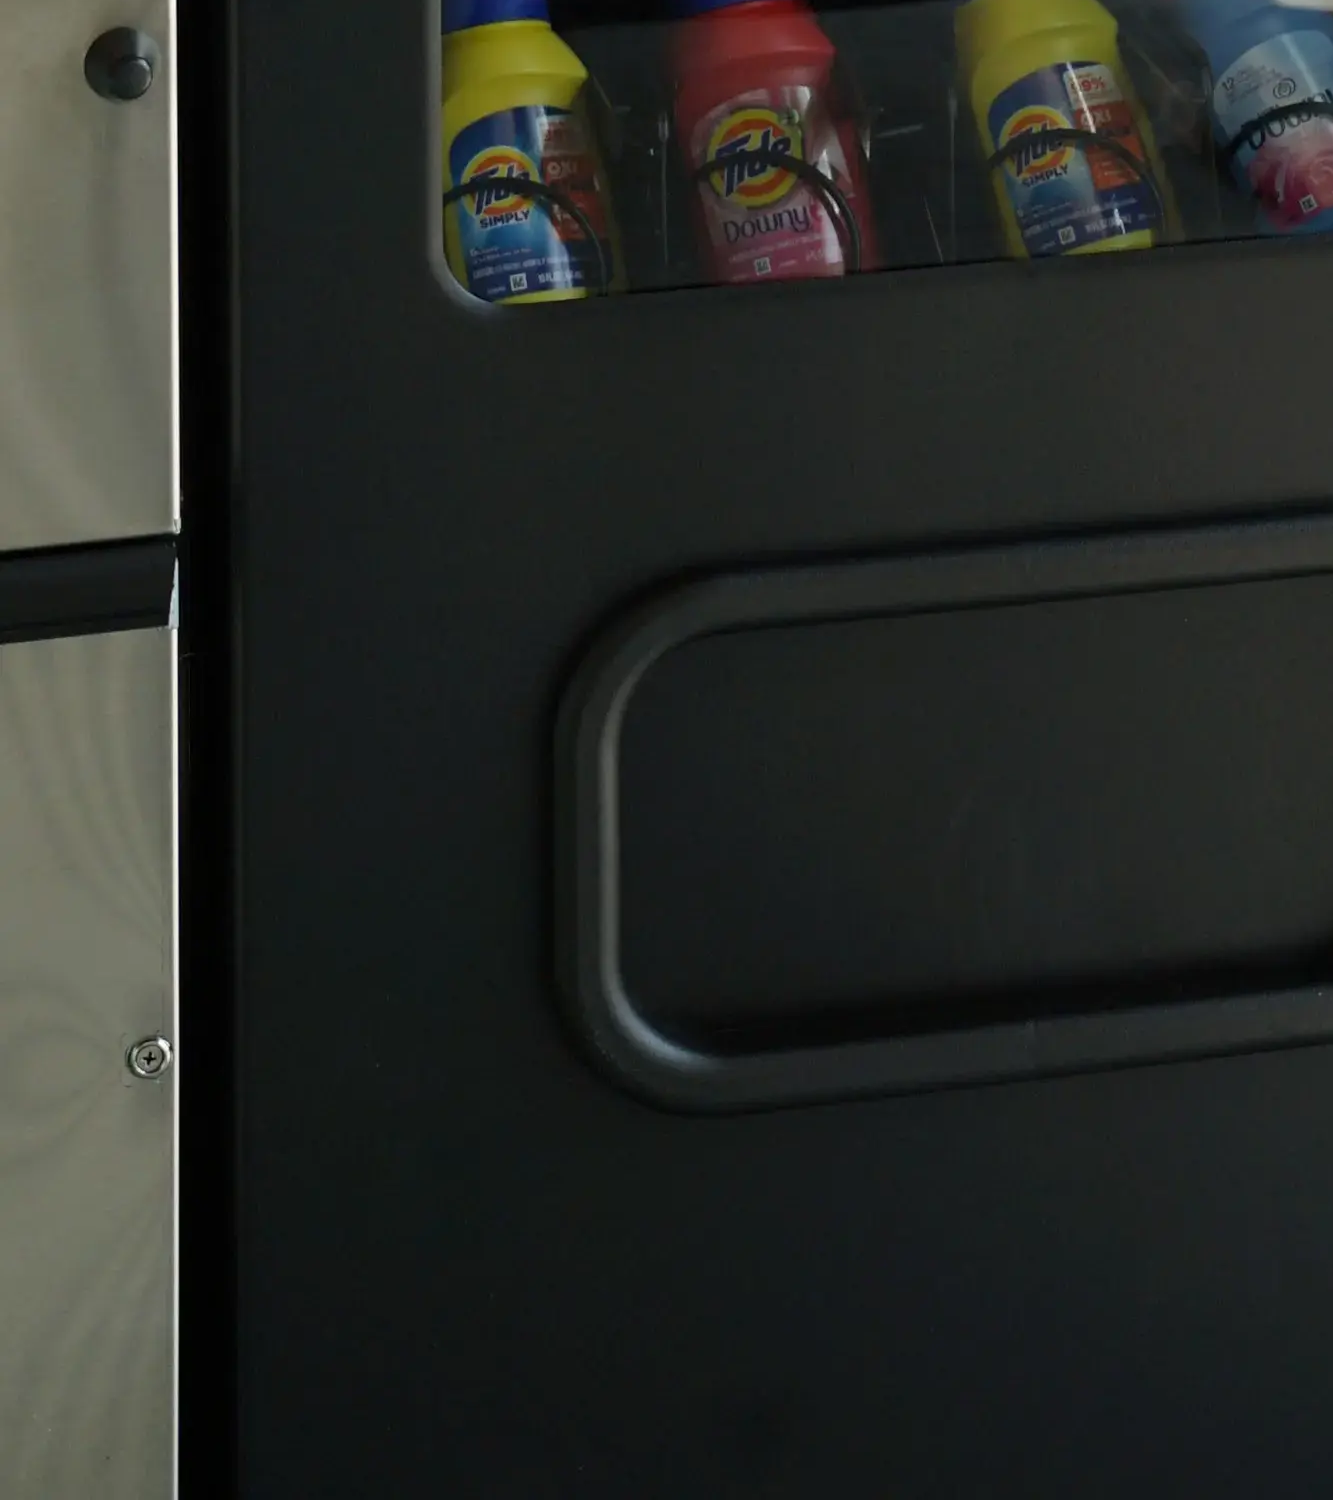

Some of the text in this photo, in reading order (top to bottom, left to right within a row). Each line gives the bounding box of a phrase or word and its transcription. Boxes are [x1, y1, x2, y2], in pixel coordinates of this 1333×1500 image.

[715, 127, 791, 197] Tide
[1022, 164, 1068, 188] SIMPLY
[480, 210, 530, 229] SIMPLY
[723, 205, 811, 243] Downy
